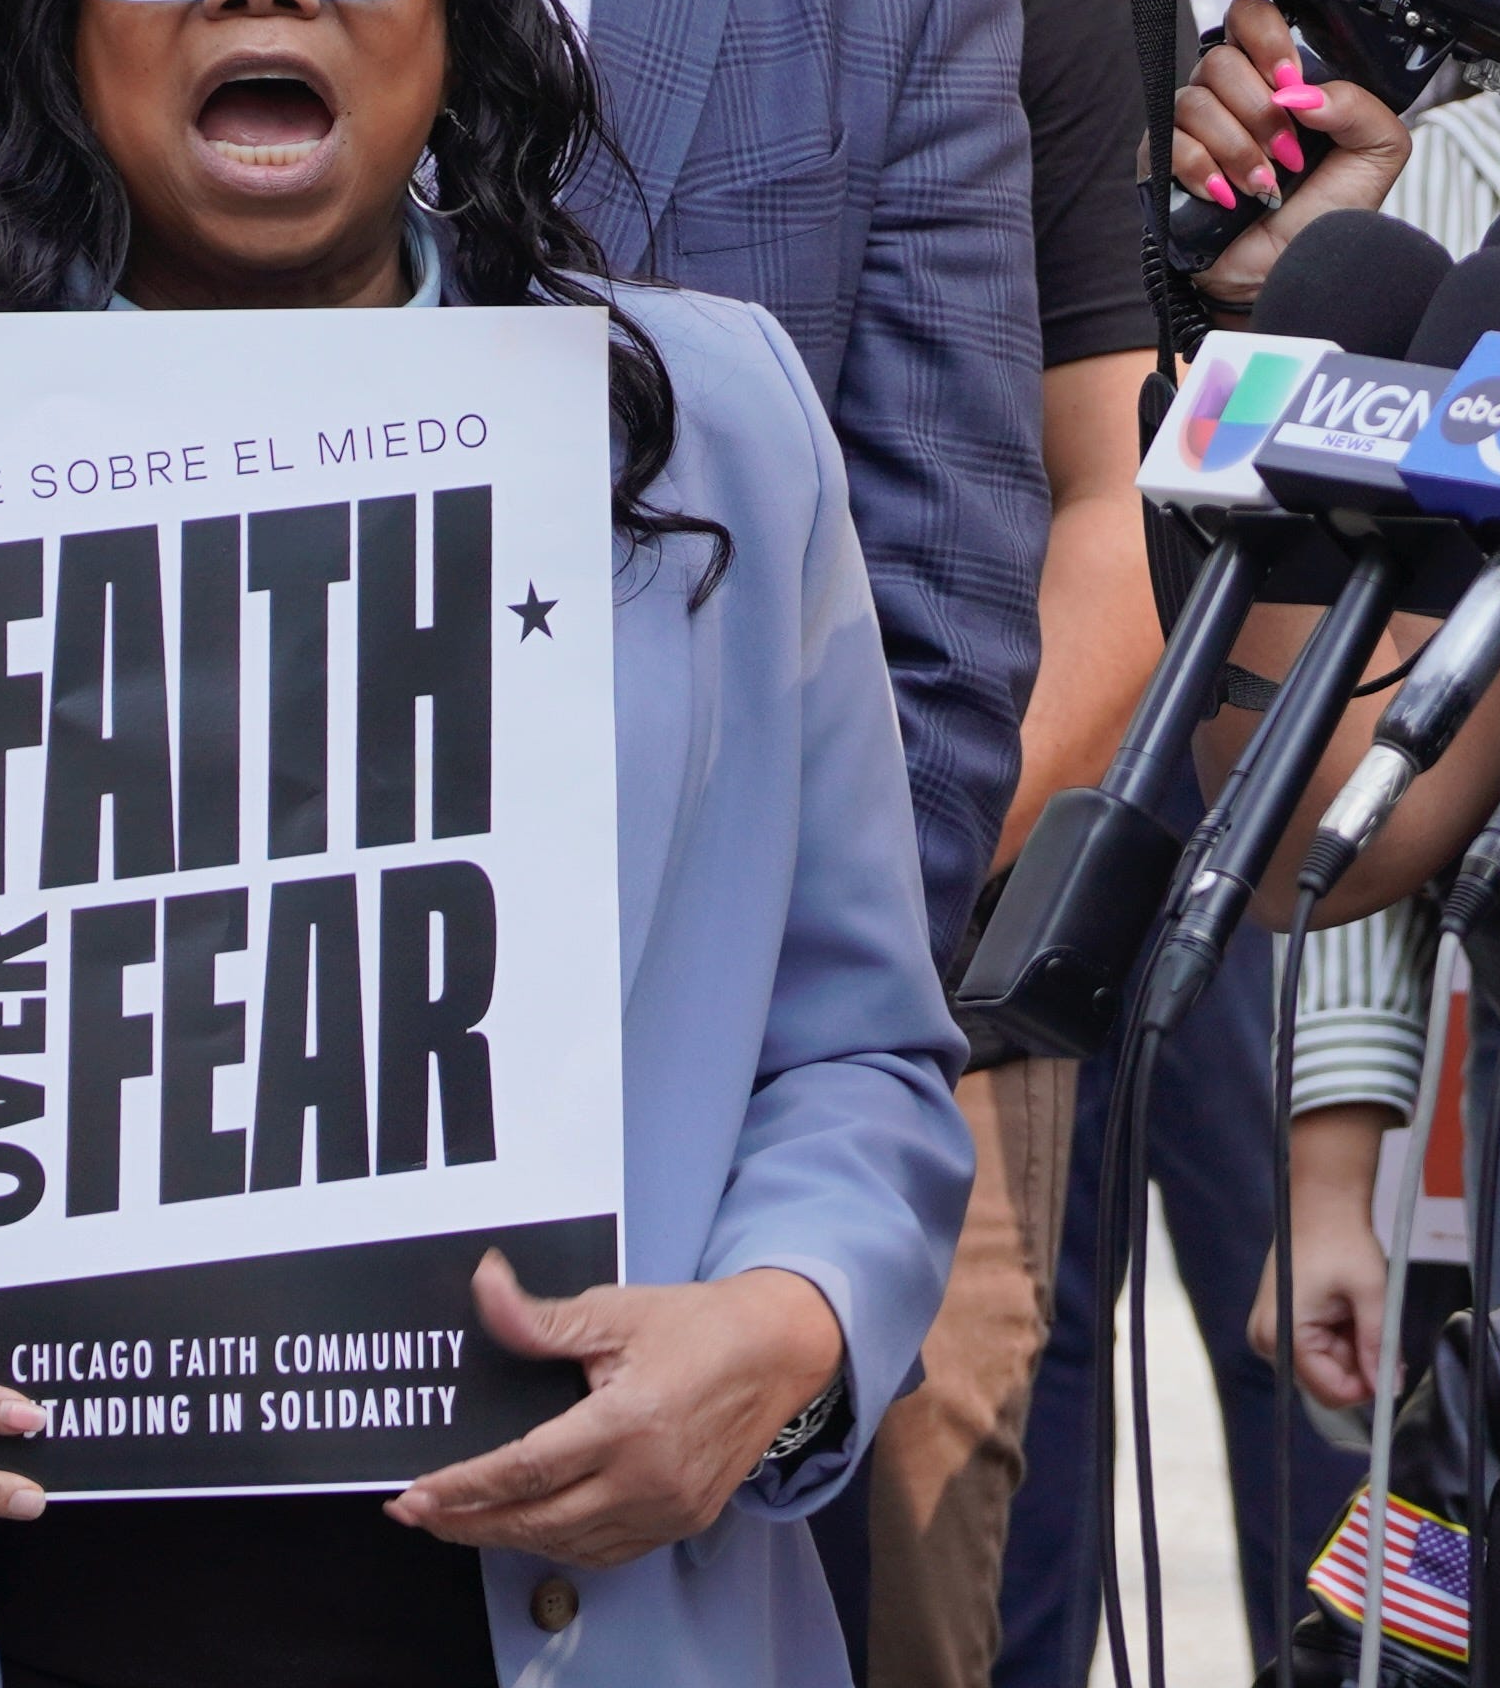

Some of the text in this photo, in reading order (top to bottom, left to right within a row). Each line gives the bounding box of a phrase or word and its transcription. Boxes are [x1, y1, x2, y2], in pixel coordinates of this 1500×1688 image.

[30, 446, 208, 500] SOBRE
[234, 436, 294, 477] EL
[317, 413, 492, 467] MIEDO
[1320, 432, 1376, 454] NEWS
[64, 859, 497, 1218] FEAR
[10, 1329, 466, 1384] CHICAGO FAITH COMMUNITY
[207, 1394, 242, 1433] IN
[259, 1385, 457, 1431] SOLIDARITY
